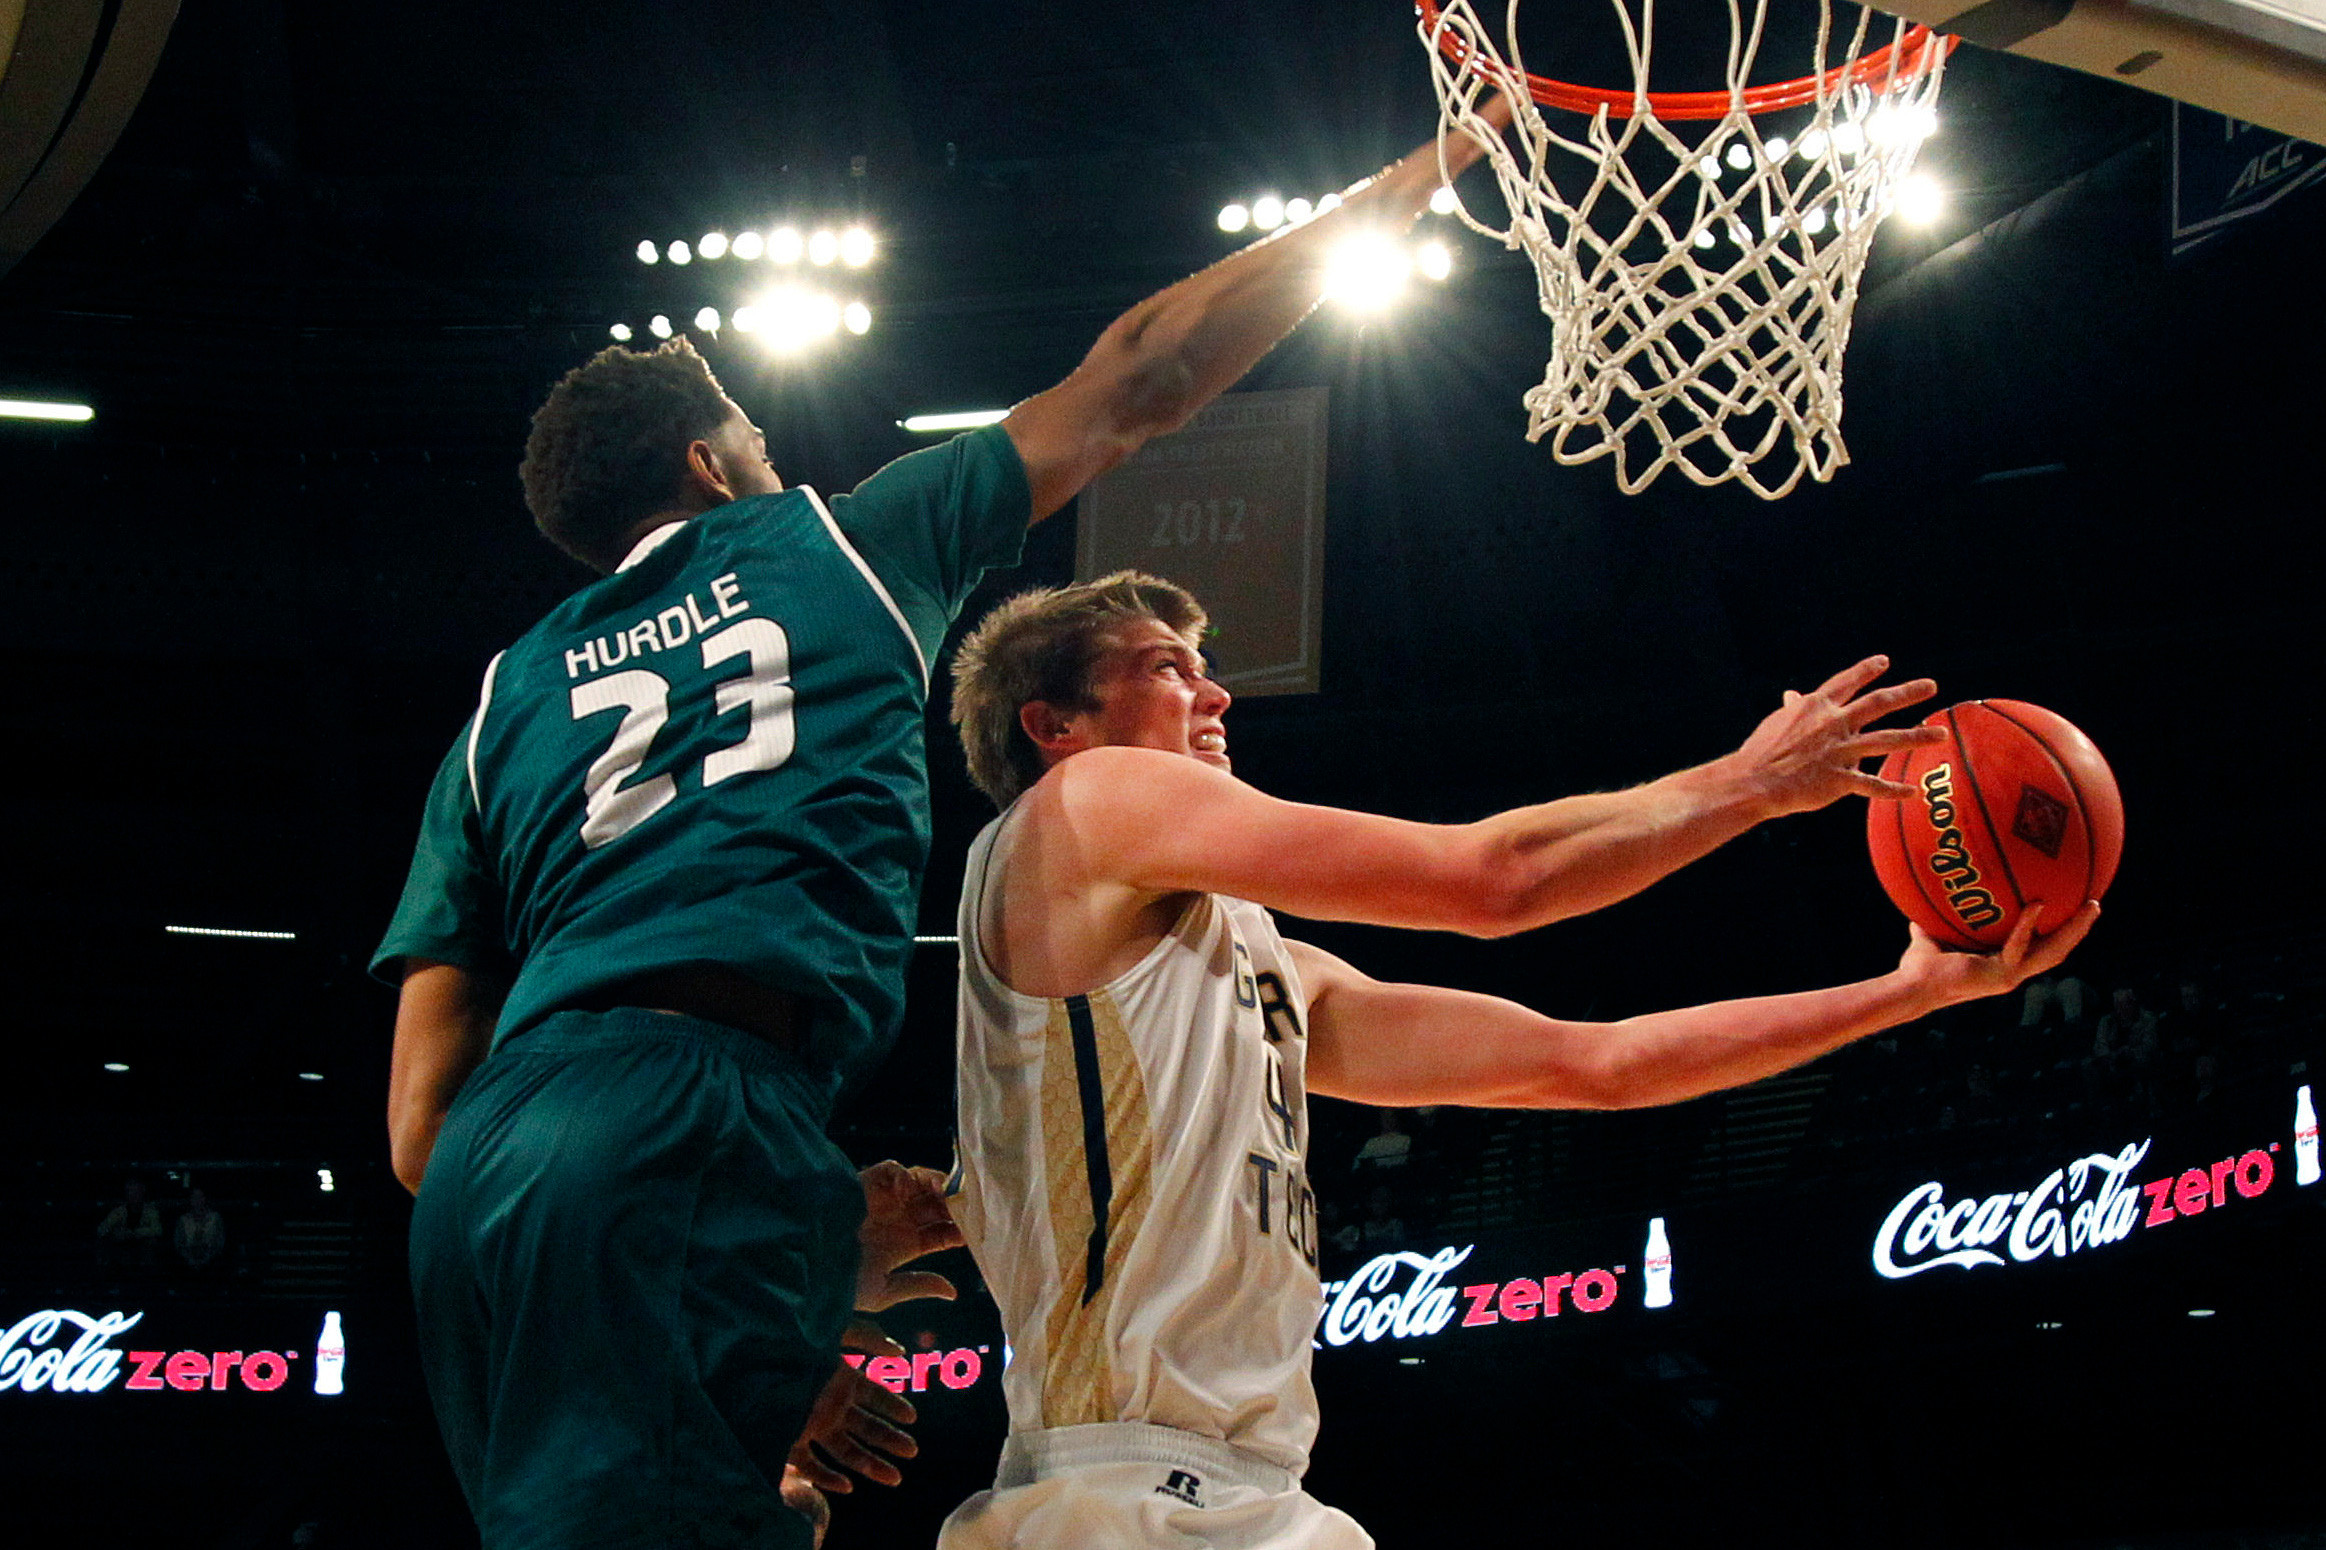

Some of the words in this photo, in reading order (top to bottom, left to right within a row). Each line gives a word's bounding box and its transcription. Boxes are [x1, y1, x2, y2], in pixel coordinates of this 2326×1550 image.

[2225, 138, 2304, 200] ACC
[1149, 499, 1248, 548] 2012
[565, 572, 750, 678] HURDLE
[570, 617, 795, 850] 23
[1921, 762, 2005, 931] Wilson
[1871, 1136, 2152, 1280] Coca-Cola
